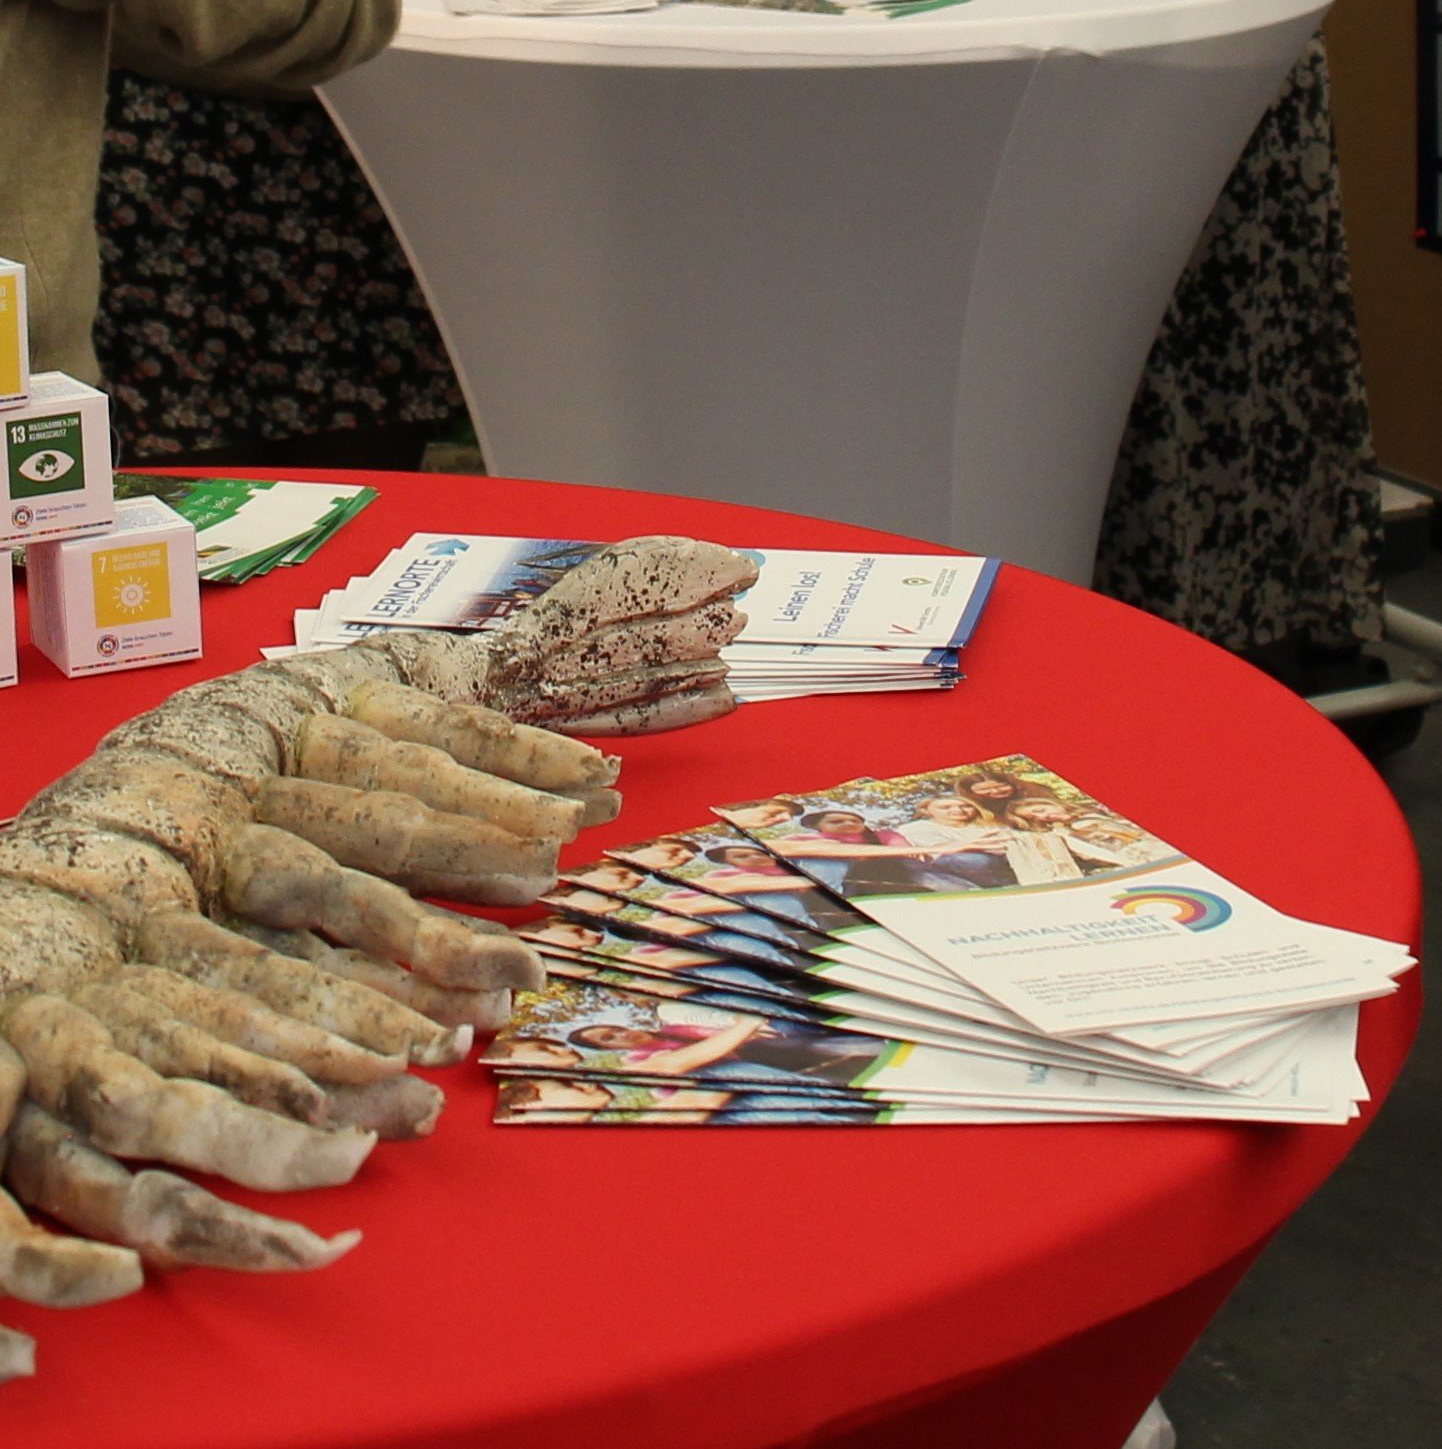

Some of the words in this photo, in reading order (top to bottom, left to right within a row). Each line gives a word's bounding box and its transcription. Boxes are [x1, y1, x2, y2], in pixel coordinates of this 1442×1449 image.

[11, 425, 26, 444] 13
[99, 556, 107, 574] 7
[365, 558, 441, 618] LERNORTE
[772, 589, 814, 623] Leinen
[947, 913, 1160, 947] NACHHALTIGKEIT
[1070, 923, 1171, 942] LERNEN
